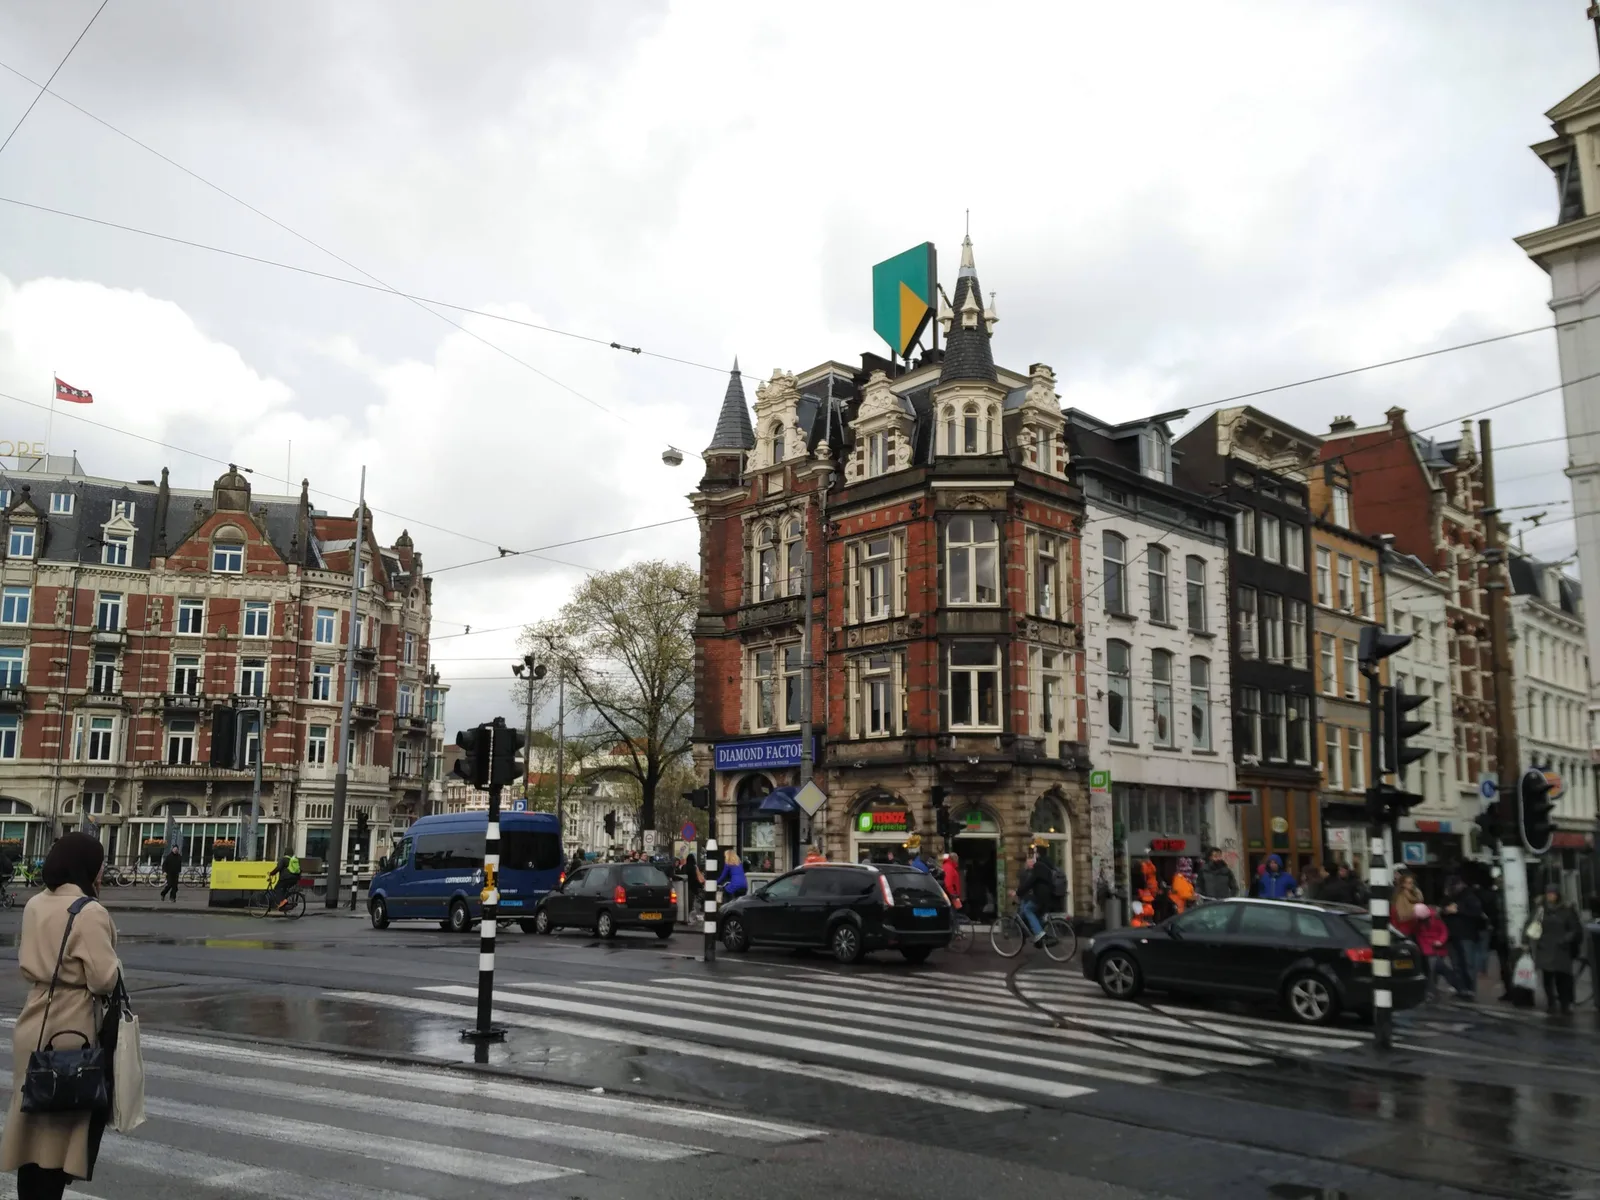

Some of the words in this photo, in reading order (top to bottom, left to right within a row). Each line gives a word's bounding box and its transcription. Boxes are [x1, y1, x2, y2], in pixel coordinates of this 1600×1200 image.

[719, 747, 764, 763] DIAMOND
[766, 743, 804, 760] FACTOR
[516, 801, 525, 811] P
